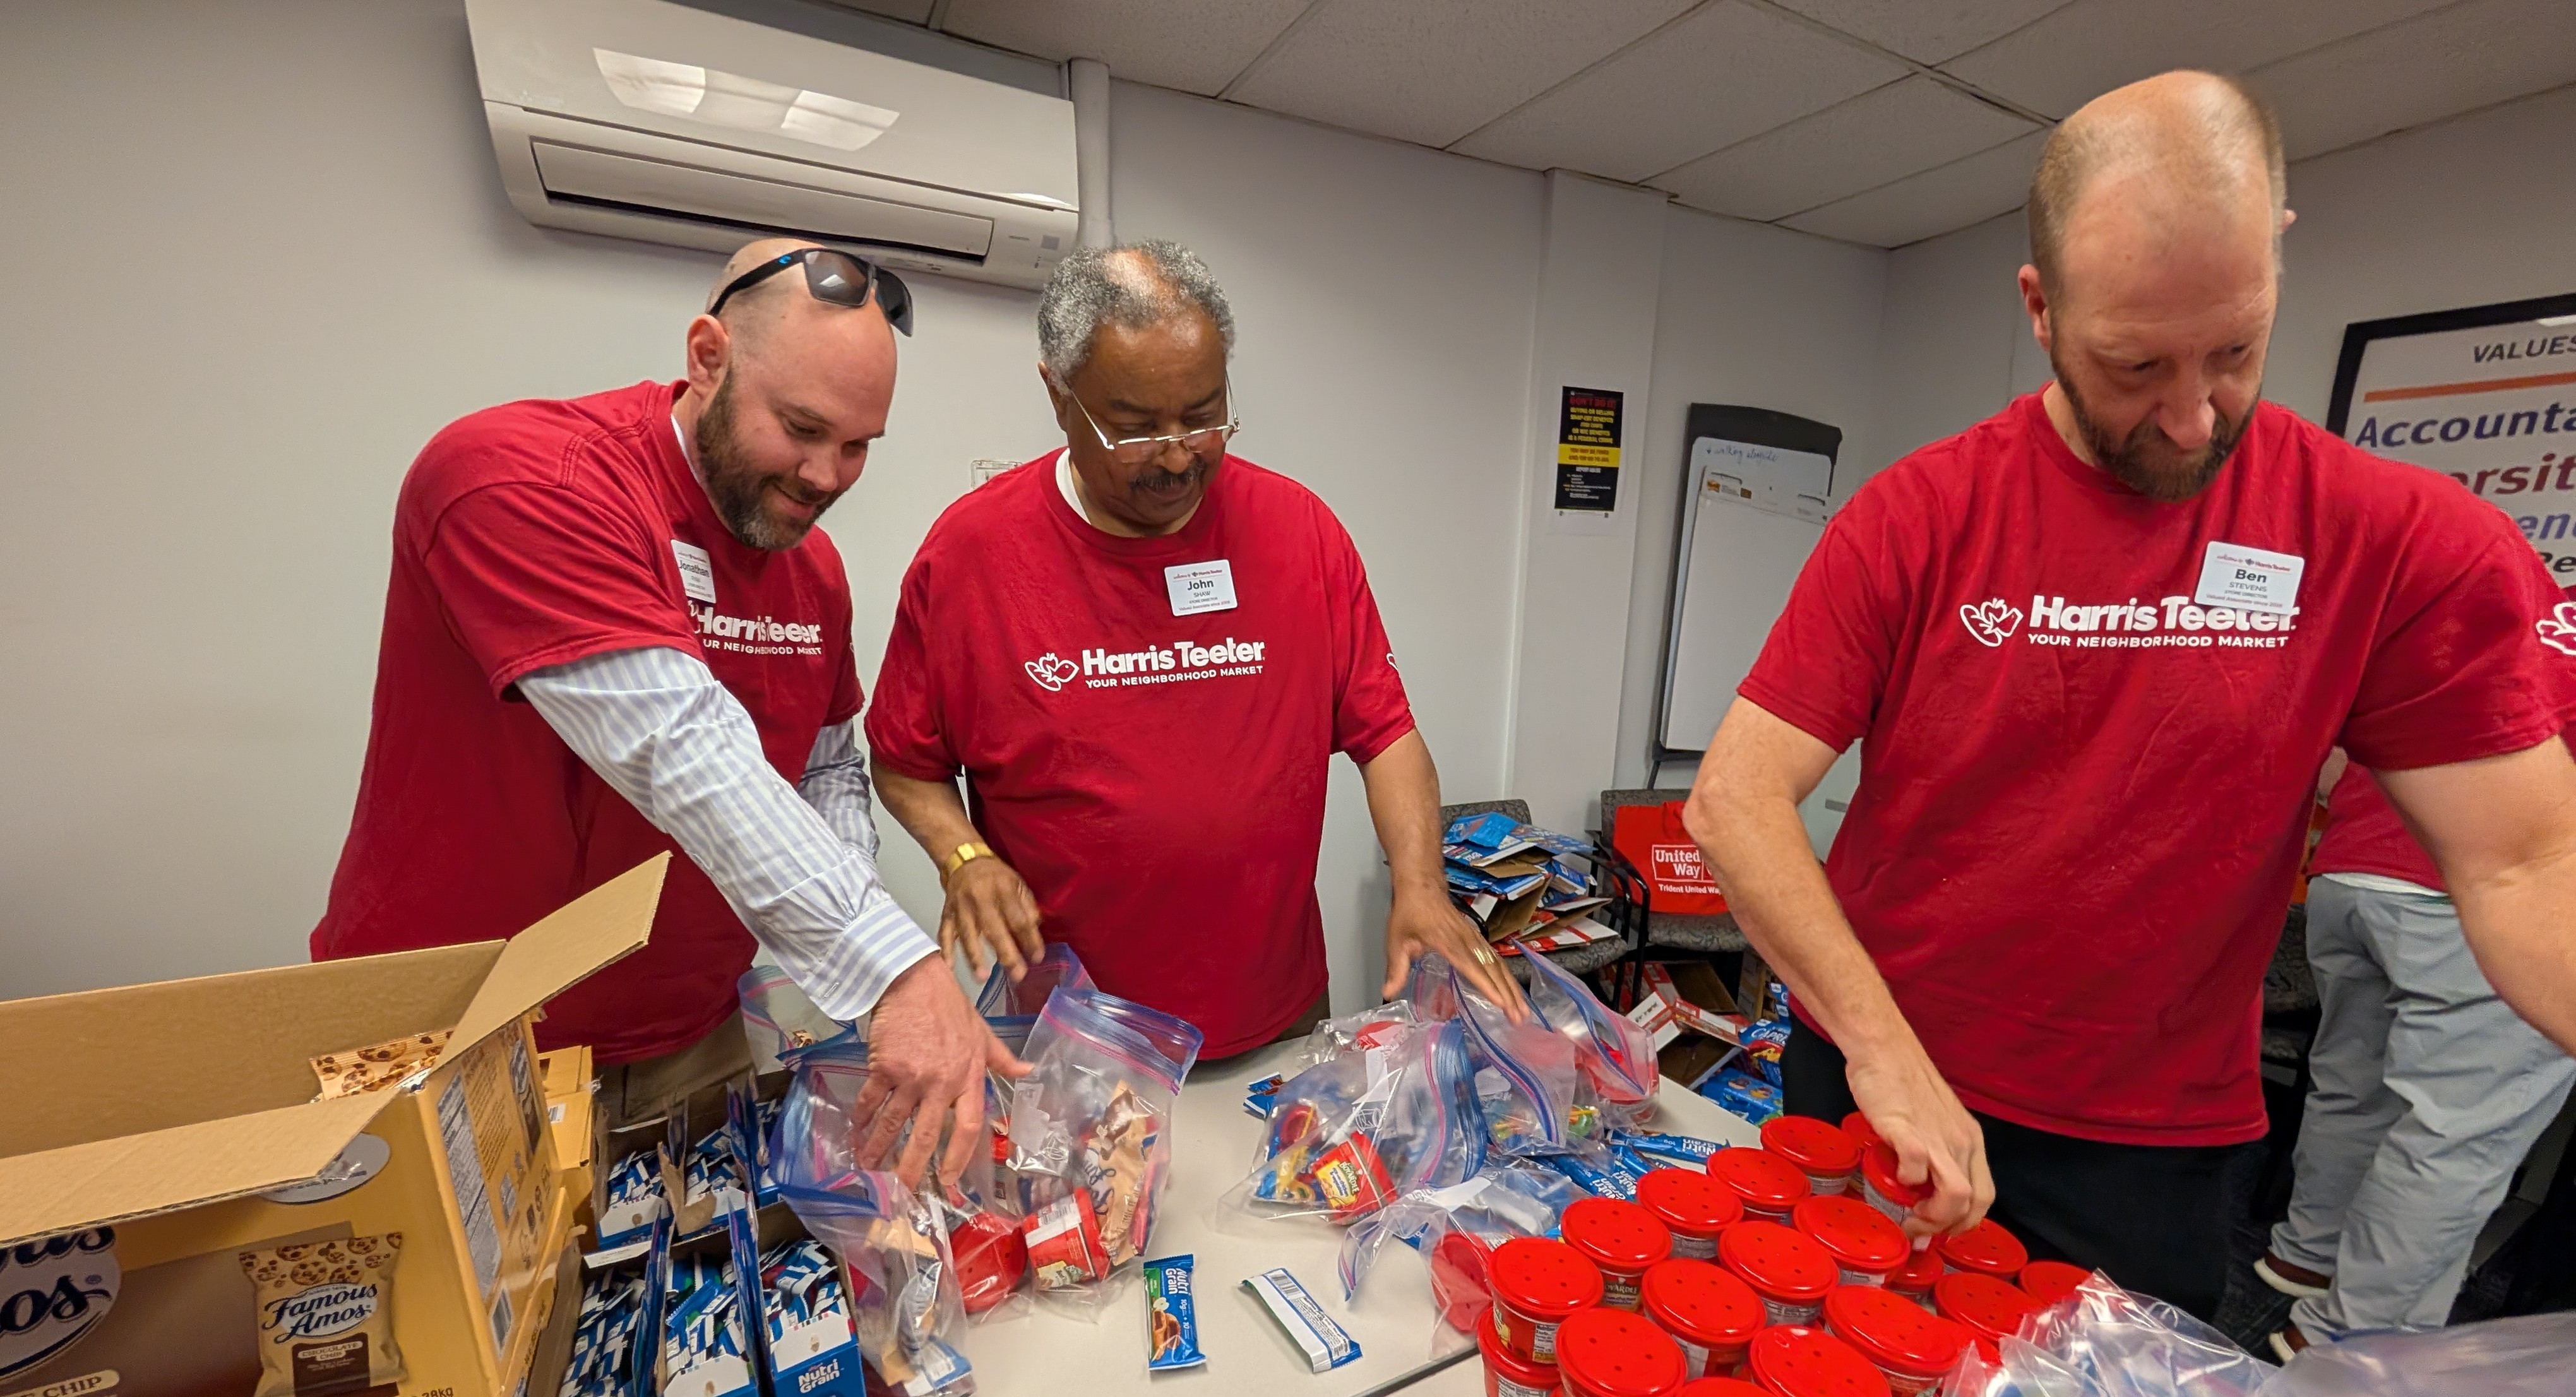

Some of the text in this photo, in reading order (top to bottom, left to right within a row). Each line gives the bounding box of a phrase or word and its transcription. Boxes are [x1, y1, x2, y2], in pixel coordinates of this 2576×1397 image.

[2516, 513, 2576, 539] en
[1187, 580, 1214, 591] John
[2229, 581, 2267, 592] STEVENS
[2235, 569, 2267, 583] Ben
[2030, 595, 2157, 631] Harris
[2027, 633, 2289, 648] YOUR NEIGHBORHOOD MARKET
[1082, 638, 1265, 676] Harris Teeter
[1085, 665, 1263, 689] YOUR NEIGHBORHOOD MARKET
[1655, 849, 1702, 863] United
[1673, 863, 1700, 879] Way
[1659, 884, 1684, 893] Trident
[1685, 885, 1707, 894] United
[1166, 1268, 1178, 1295] Grain
[1176, 1268, 1192, 1297] Nutri
[262, 1283, 378, 1330] Famous
[274, 1304, 372, 1343] Amos
[302, 1343, 359, 1357] CHOCOLATE
[319, 1351, 343, 1360] CHIP
[798, 1358, 839, 1387] Nutri
[800, 1370, 840, 1394] Grain
[42, 1376, 102, 1397] CHIP
